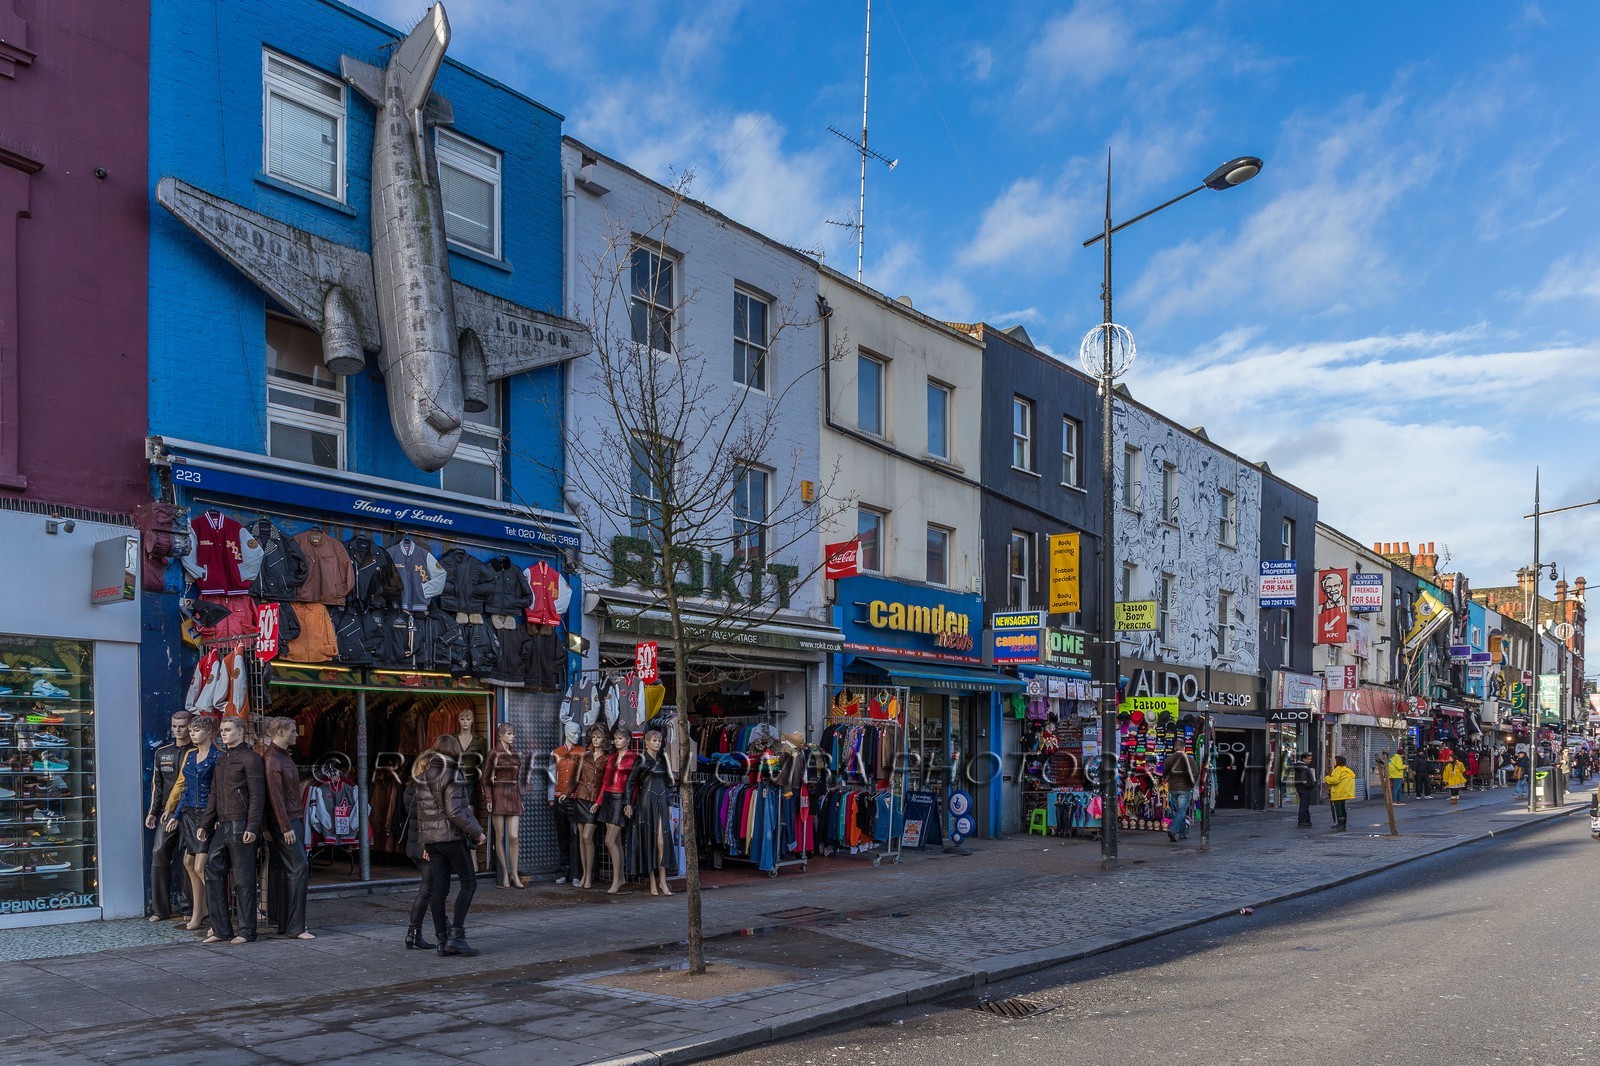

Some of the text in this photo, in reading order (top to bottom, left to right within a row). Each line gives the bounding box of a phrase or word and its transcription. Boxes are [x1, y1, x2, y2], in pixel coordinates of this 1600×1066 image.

[496, 316, 569, 348] LONDON
[176, 469, 201, 483] 223
[352, 499, 392, 515] House
[394, 508, 410, 519] of
[410, 509, 454, 526] Leather
[518, 528, 536, 539] 020
[1054, 548, 1074, 556] piercing
[613, 536, 800, 608] ROKIT
[94, 586, 120, 599] OFFSPRING
[1122, 604, 1148, 612] tattoo
[259, 608, 278, 640] 50%
[870, 600, 968, 636] camden
[996, 615, 1039, 626] NEWSAGENTS
[256, 640, 275, 652] OFF
[800, 640, 842, 652] www.rokit.co.uk
[938, 630, 974, 650] news
[995, 634, 1037, 647] camden
[1046, 632, 1084, 654] OME
[1010, 644, 1038, 652] news
[637, 646, 656, 670] 50%
[1060, 656, 1077, 664] PIERCING
[637, 669, 655, 679] OFF
[1133, 668, 1199, 703] ALDO
[1133, 698, 1167, 710] tattoo
[1200, 690, 1251, 707] SALE SHOP
[1342, 691, 1360, 712] KFC
[1271, 712, 1308, 720] ALDO
[1218, 742, 1245, 752] DO
[0, 894, 94, 913] PRING.CO.UK
